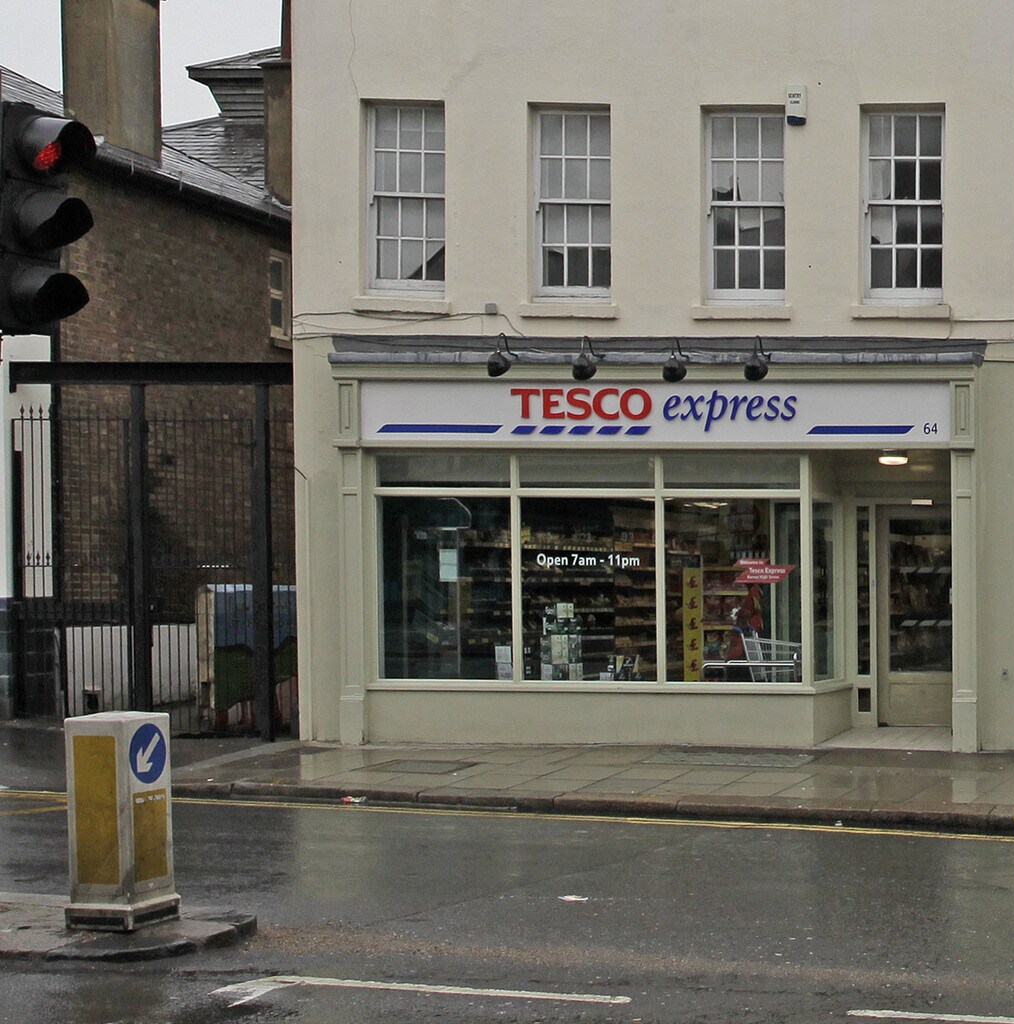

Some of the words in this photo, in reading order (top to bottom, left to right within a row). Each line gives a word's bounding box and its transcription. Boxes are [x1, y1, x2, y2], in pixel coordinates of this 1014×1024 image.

[510, 388, 652, 420] TESCO
[662, 389, 797, 432] express
[923, 422, 938, 435] 64
[537, 553, 569, 569] Open
[571, 553, 597, 566] 7am
[607, 554, 640, 569] 11pm
